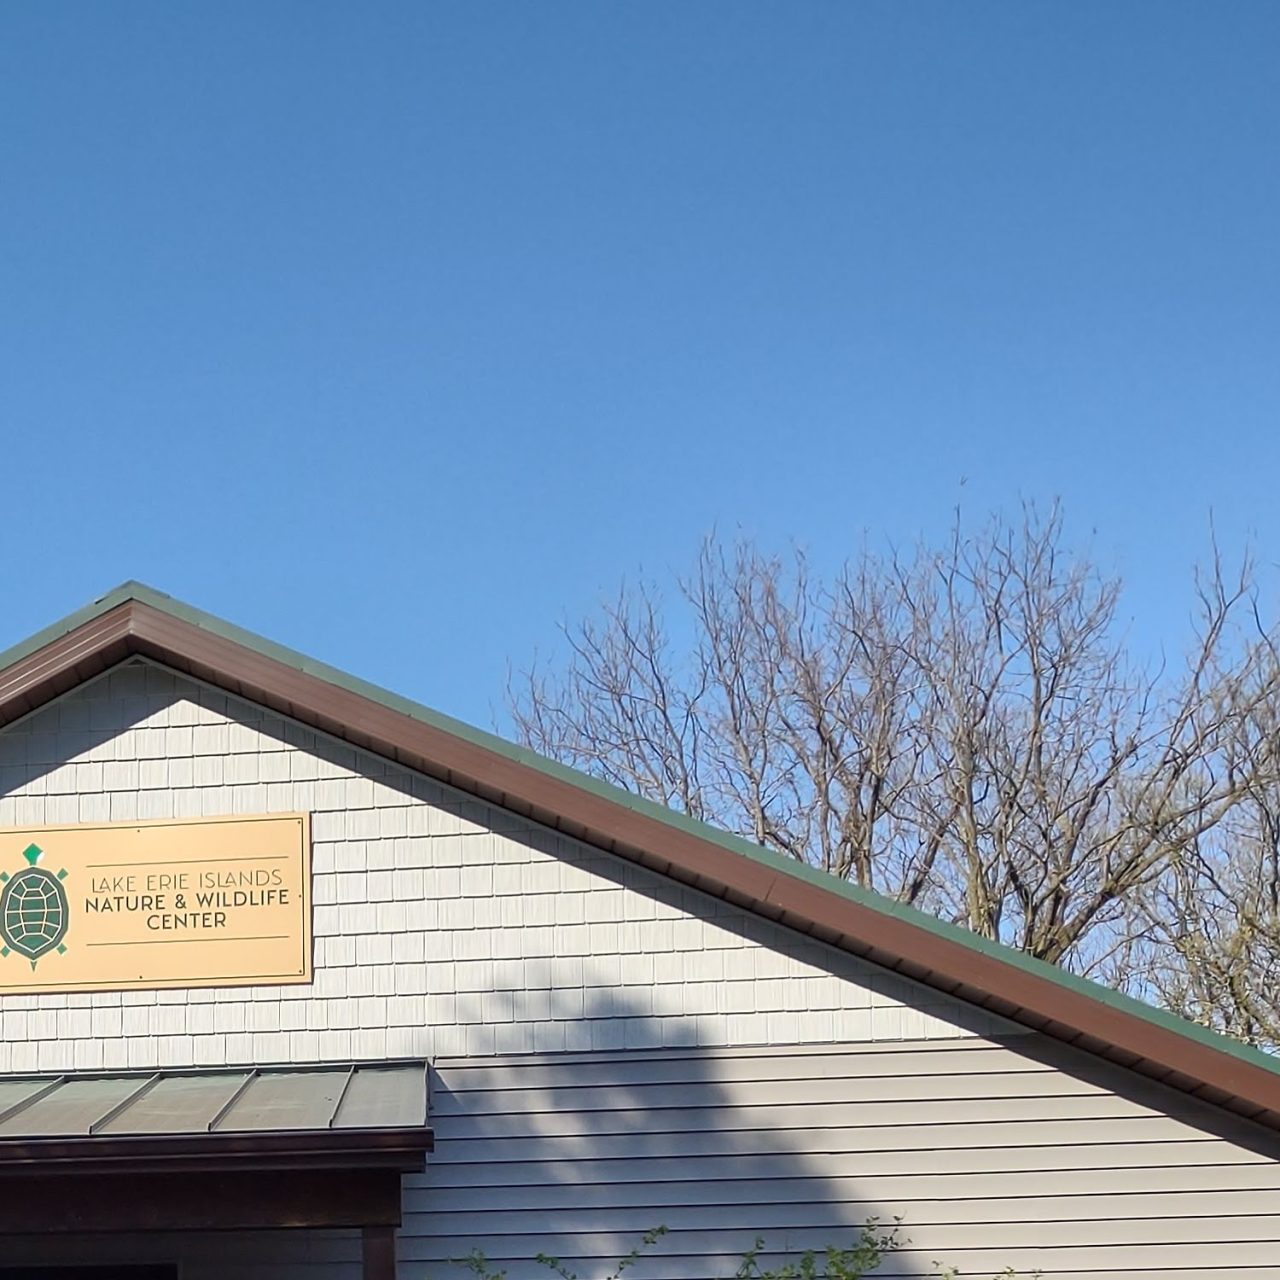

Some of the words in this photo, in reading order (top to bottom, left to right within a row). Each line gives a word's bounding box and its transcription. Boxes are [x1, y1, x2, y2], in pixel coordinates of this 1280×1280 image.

[92, 876, 137, 893] LAKE
[147, 873, 190, 891] ERIE
[199, 869, 283, 888] ISLANDS
[85, 894, 166, 913] NATURE
[174, 893, 187, 910] &
[196, 889, 289, 907] WILDLIFE
[146, 912, 226, 930] CENTER
